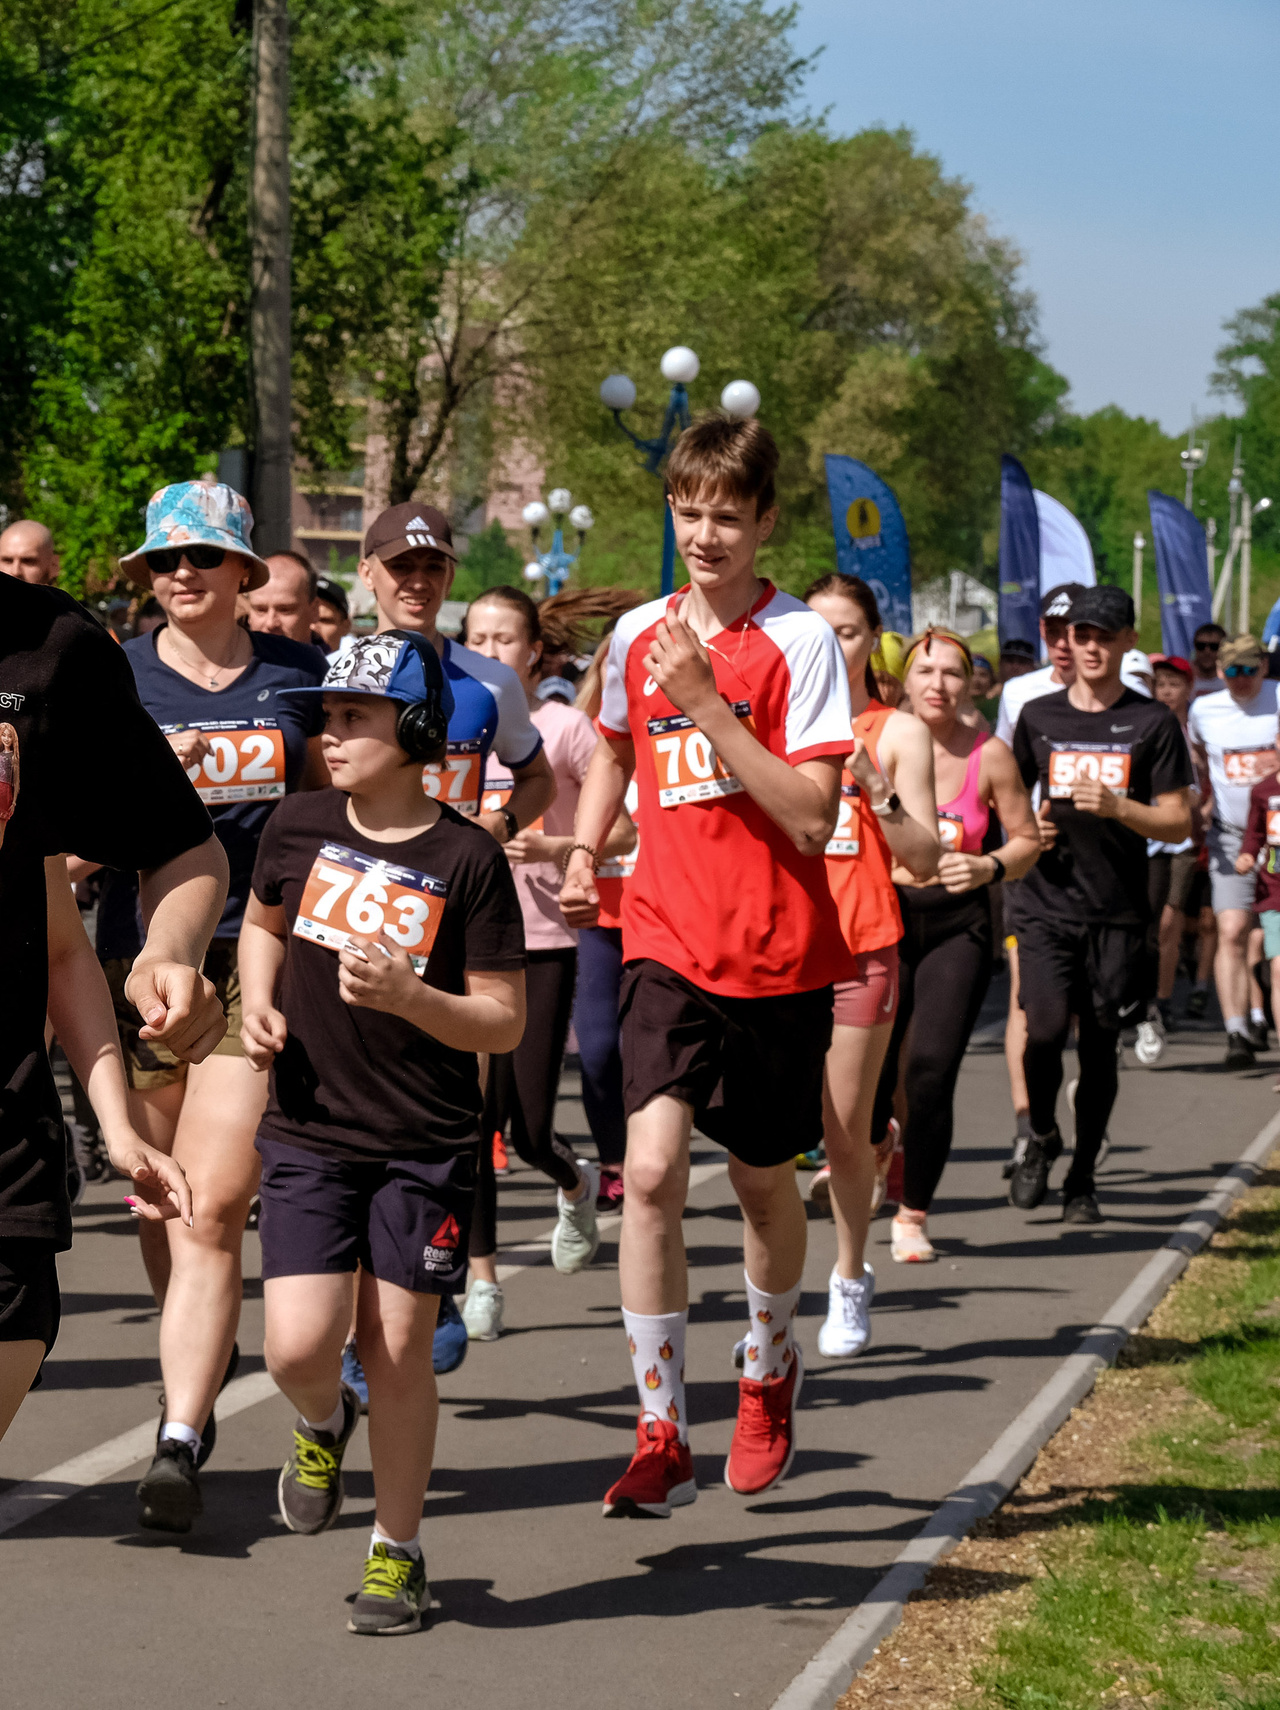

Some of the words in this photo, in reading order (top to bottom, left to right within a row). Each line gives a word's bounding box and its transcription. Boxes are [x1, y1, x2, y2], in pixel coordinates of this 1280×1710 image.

[191, 734, 276, 783] 02
[655, 731, 730, 785] 70
[1053, 754, 1125, 786] 505
[1226, 754, 1258, 778] 43
[311, 866, 430, 948] 763
